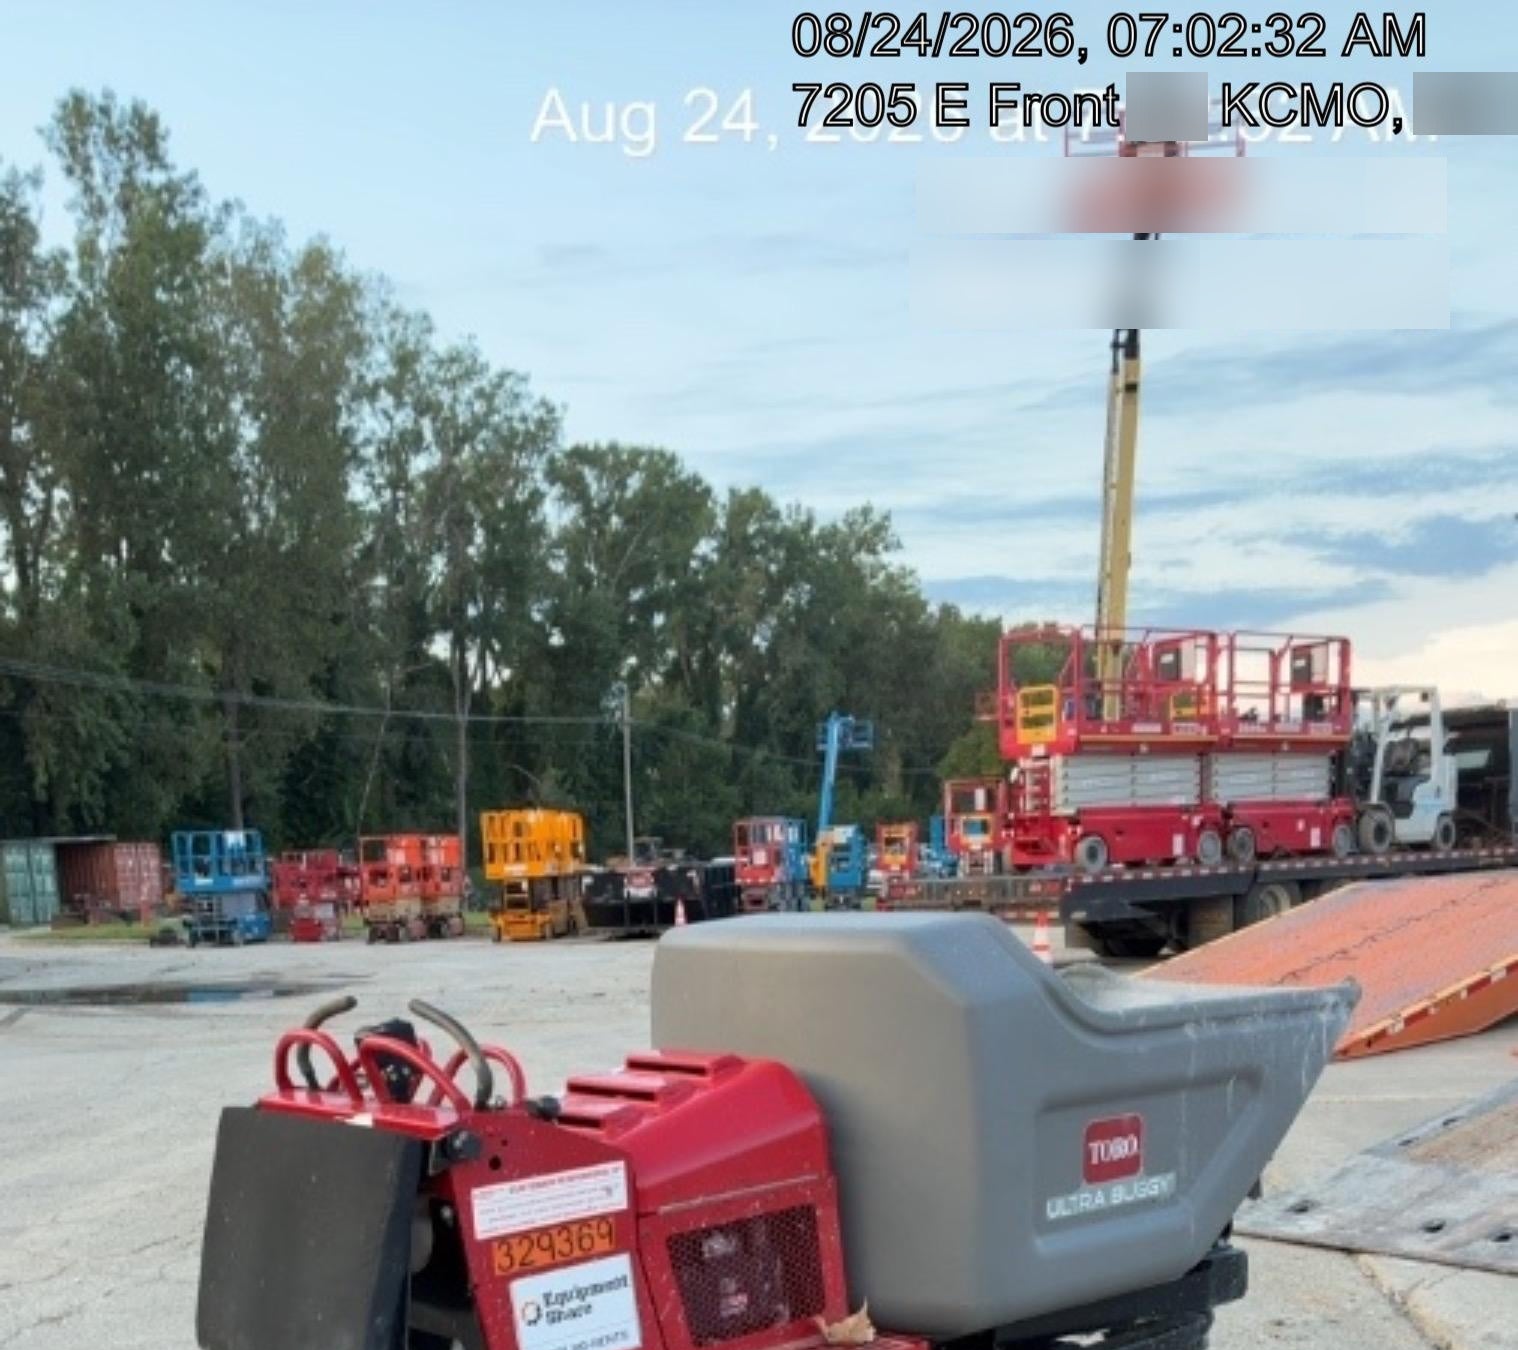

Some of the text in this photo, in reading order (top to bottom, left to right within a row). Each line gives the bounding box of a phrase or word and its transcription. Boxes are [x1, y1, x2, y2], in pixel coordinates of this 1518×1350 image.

[1088, 1134, 1138, 1165] TORO
[1047, 1172, 1175, 1219] ULTRA BUGGY
[497, 1219, 613, 1272] 329369
[542, 1274, 629, 1309] Equipment
